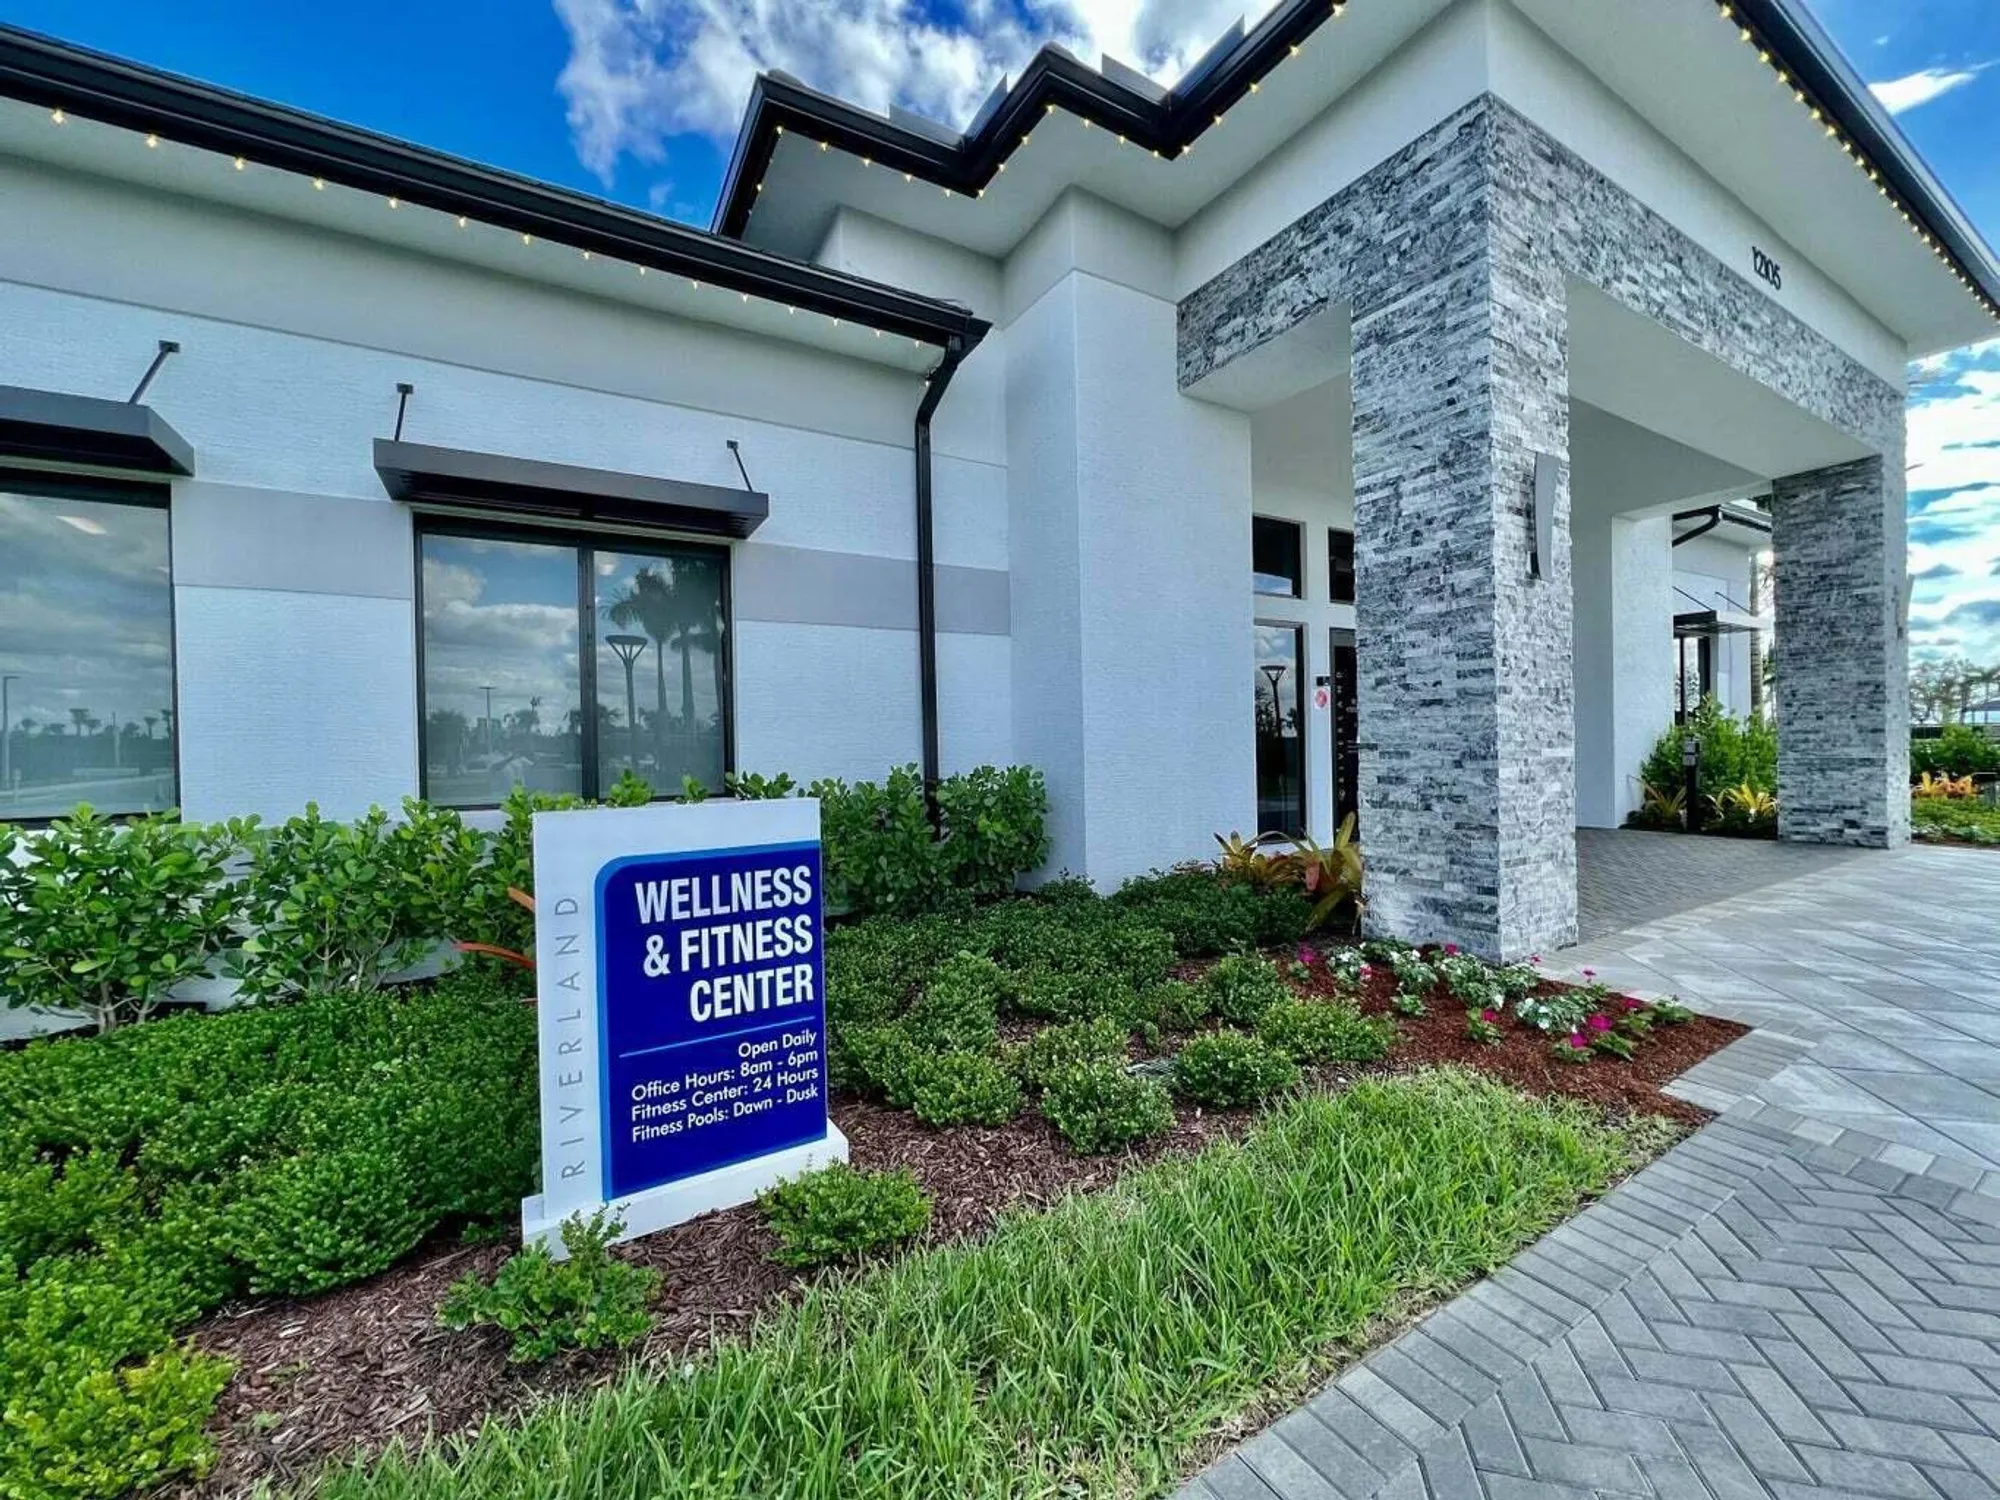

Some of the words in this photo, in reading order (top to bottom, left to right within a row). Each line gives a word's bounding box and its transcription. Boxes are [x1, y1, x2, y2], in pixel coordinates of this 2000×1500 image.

[634, 865, 812, 924] WELLNESS
[643, 934, 671, 978] &
[680, 914, 813, 972] FITNESS
[689, 963, 814, 1022] CENTER
[555, 896, 586, 1180] RIVERLAND
[738, 1039, 778, 1059] Open
[782, 1029, 817, 1049] Daily
[631, 1080, 681, 1101] Office
[685, 1068, 735, 1089] Hours:
[740, 1060, 773, 1077] 8am
[788, 1050, 818, 1068] 6pm
[631, 1098, 687, 1122] Fitness
[692, 1084, 748, 1107] Center:
[753, 1075, 772, 1093] 24
[777, 1067, 819, 1087] Hours
[632, 1119, 683, 1143] Fitness
[687, 1107, 729, 1129] Pools:
[733, 1097, 773, 1117] Dawn
[786, 1084, 819, 1104] Dusk
